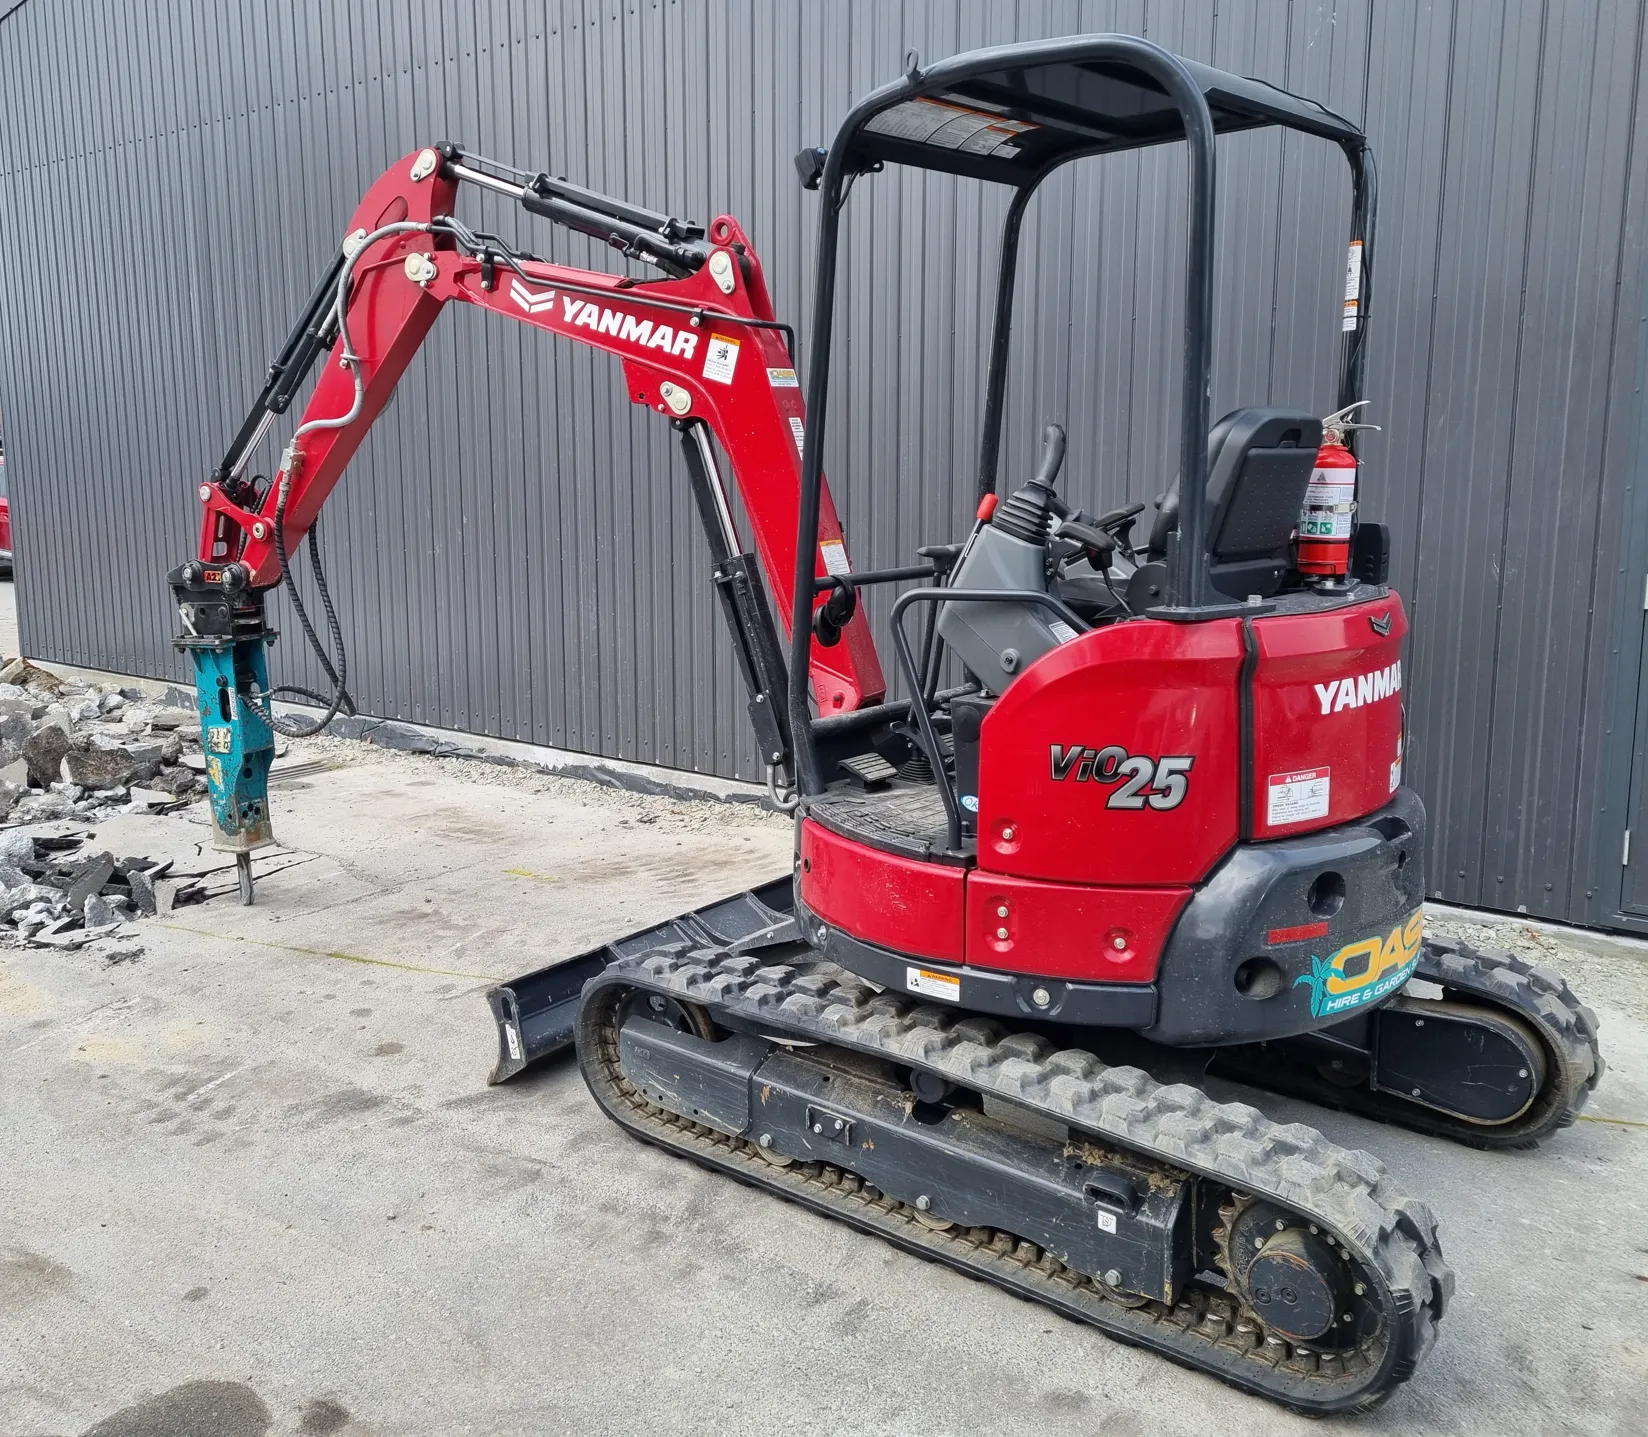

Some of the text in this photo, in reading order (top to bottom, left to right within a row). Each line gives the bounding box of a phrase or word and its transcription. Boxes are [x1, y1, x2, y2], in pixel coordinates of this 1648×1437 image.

[562, 296, 698, 359] YANMAR
[1292, 772, 1317, 782] DANGER
[1326, 993, 1361, 1011] HIRE
[1362, 988, 1373, 1001] &
[1374, 970, 1411, 996] GARDEN
